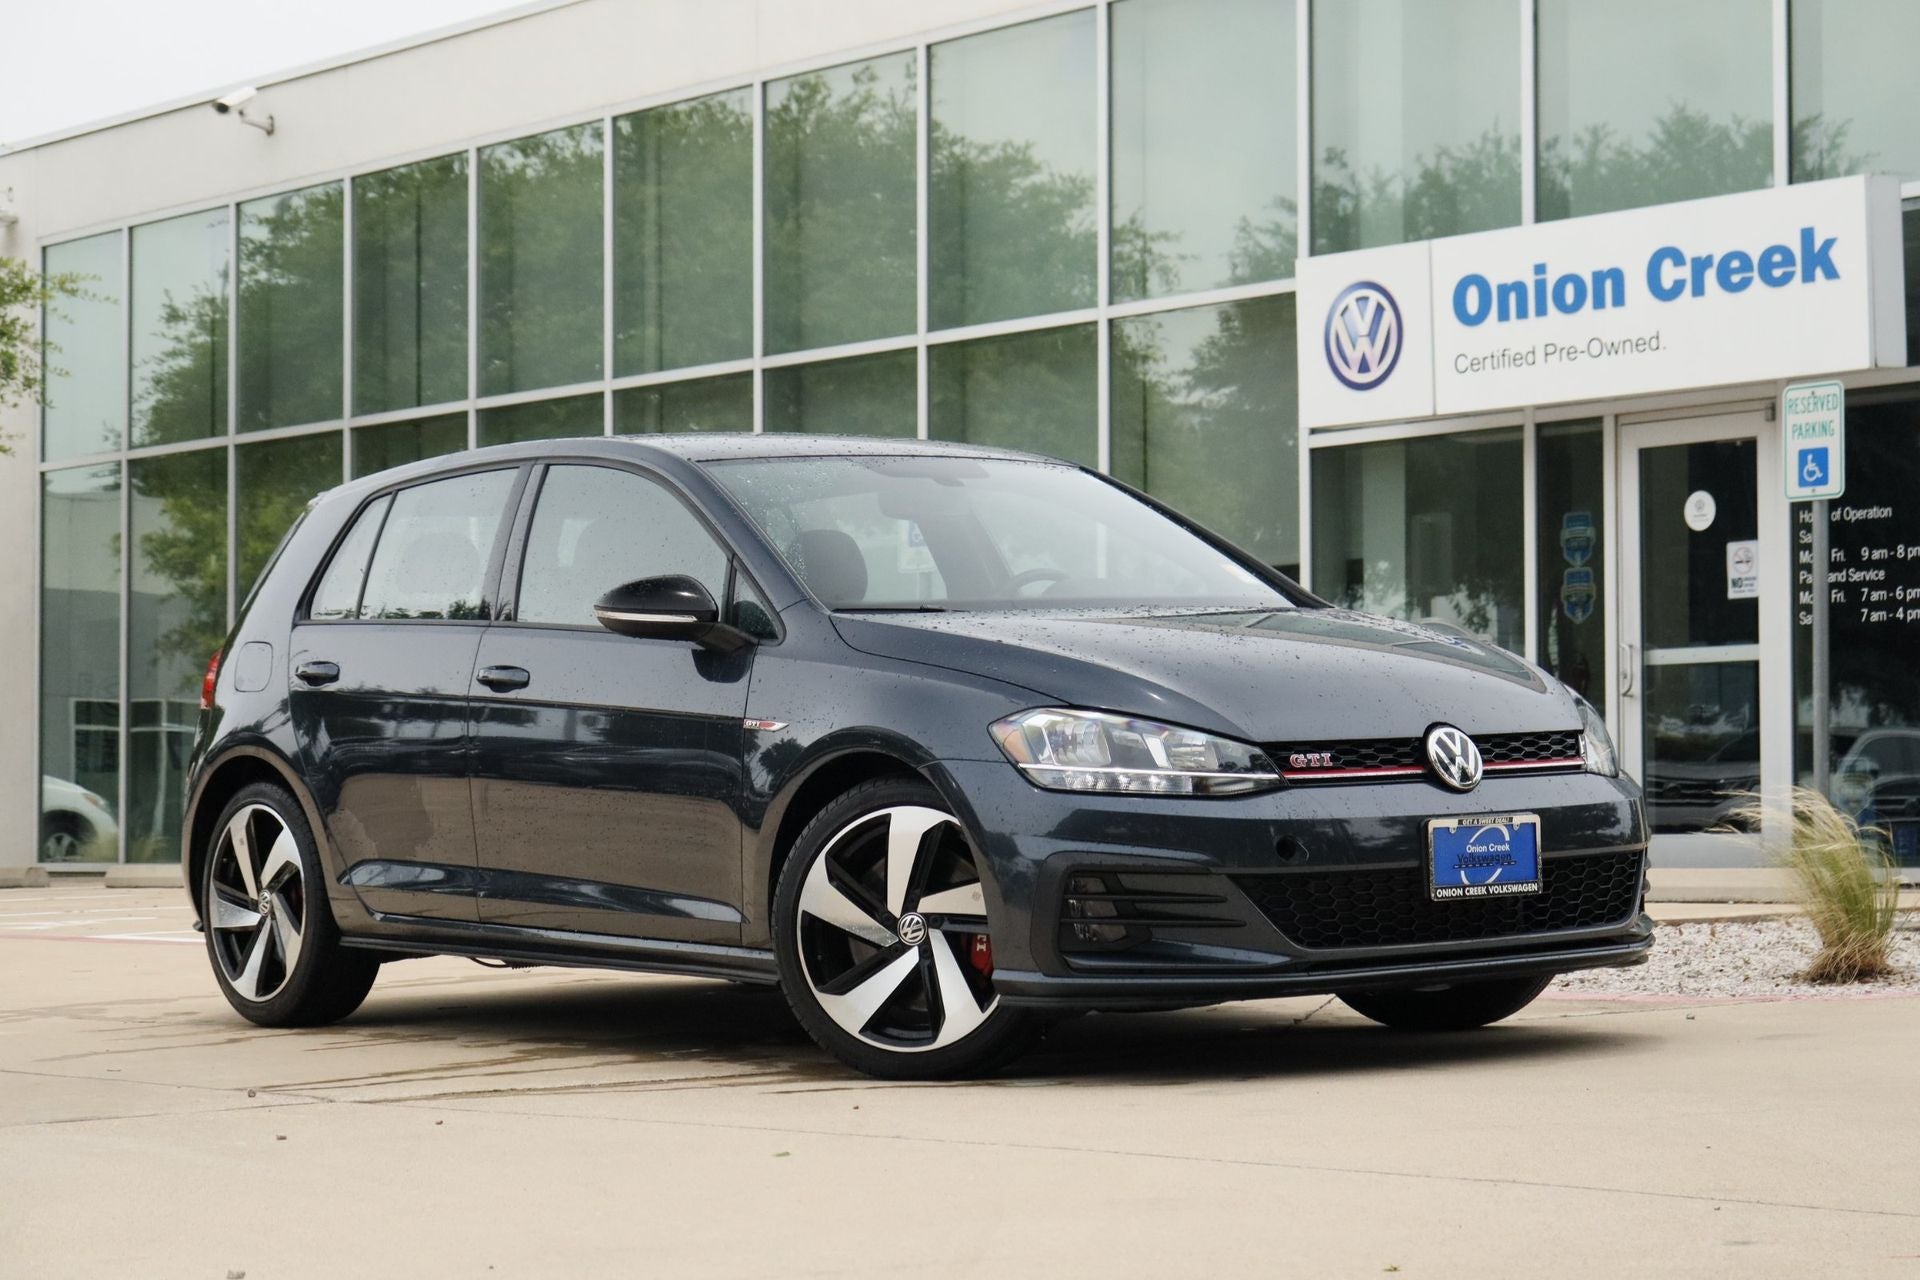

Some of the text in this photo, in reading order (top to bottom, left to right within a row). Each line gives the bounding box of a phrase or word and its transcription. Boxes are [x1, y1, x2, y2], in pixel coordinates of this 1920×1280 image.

[1453, 226, 1841, 327] Onion Creek
[1454, 331, 1667, 374] Certified Pre-Owned.
[1788, 394, 1838, 414] RESERVED
[1792, 420, 1835, 440] PARKING
[1831, 507, 1841, 522] of
[1843, 505, 1893, 523] Operation
[1831, 548, 1846, 562] Fri.
[1861, 546, 1869, 560] 9
[1871, 548, 1888, 560] am
[1896, 544, 1905, 558] 8
[1827, 568, 1847, 583] and
[1848, 567, 1886, 582] Service
[1831, 588, 1846, 603] Fri.
[1861, 587, 1869, 602] 7
[1870, 590, 1887, 602] am
[1895, 585, 1904, 600] 6
[1861, 608, 1869, 622] 7
[1870, 610, 1887, 622] am
[1895, 606, 1904, 620] 4
[1289, 753, 1333, 768] GTI
[1466, 843, 1510, 853] Onion Creek
[1456, 853, 1512, 864] Volkswagen
[1436, 882, 1538, 898] ONION CREEK VOLKSWAGEN
